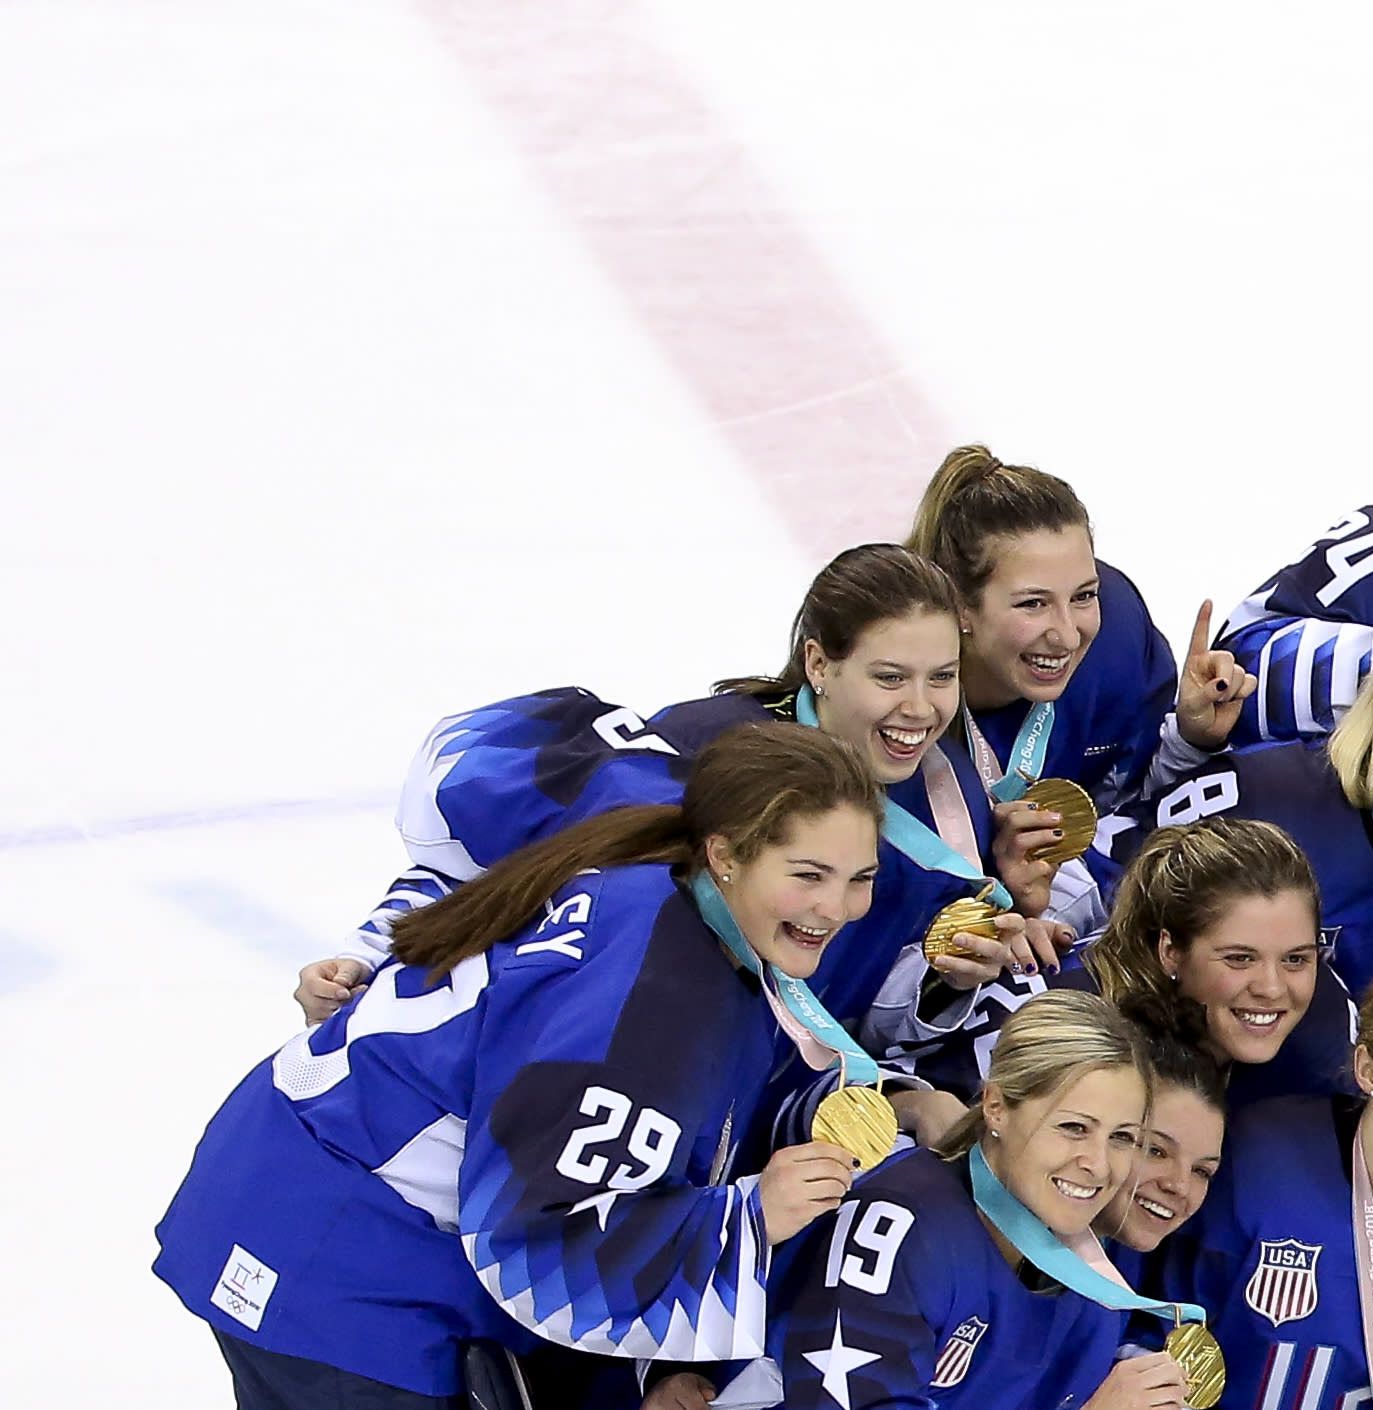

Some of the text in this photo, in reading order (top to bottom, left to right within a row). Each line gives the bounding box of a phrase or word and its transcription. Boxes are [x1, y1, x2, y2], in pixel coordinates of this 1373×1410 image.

[1157, 769, 1239, 829] 8
[555, 1086, 683, 1192] 29
[823, 1199, 916, 1297] 19
[1268, 1246, 1308, 1270] USA
